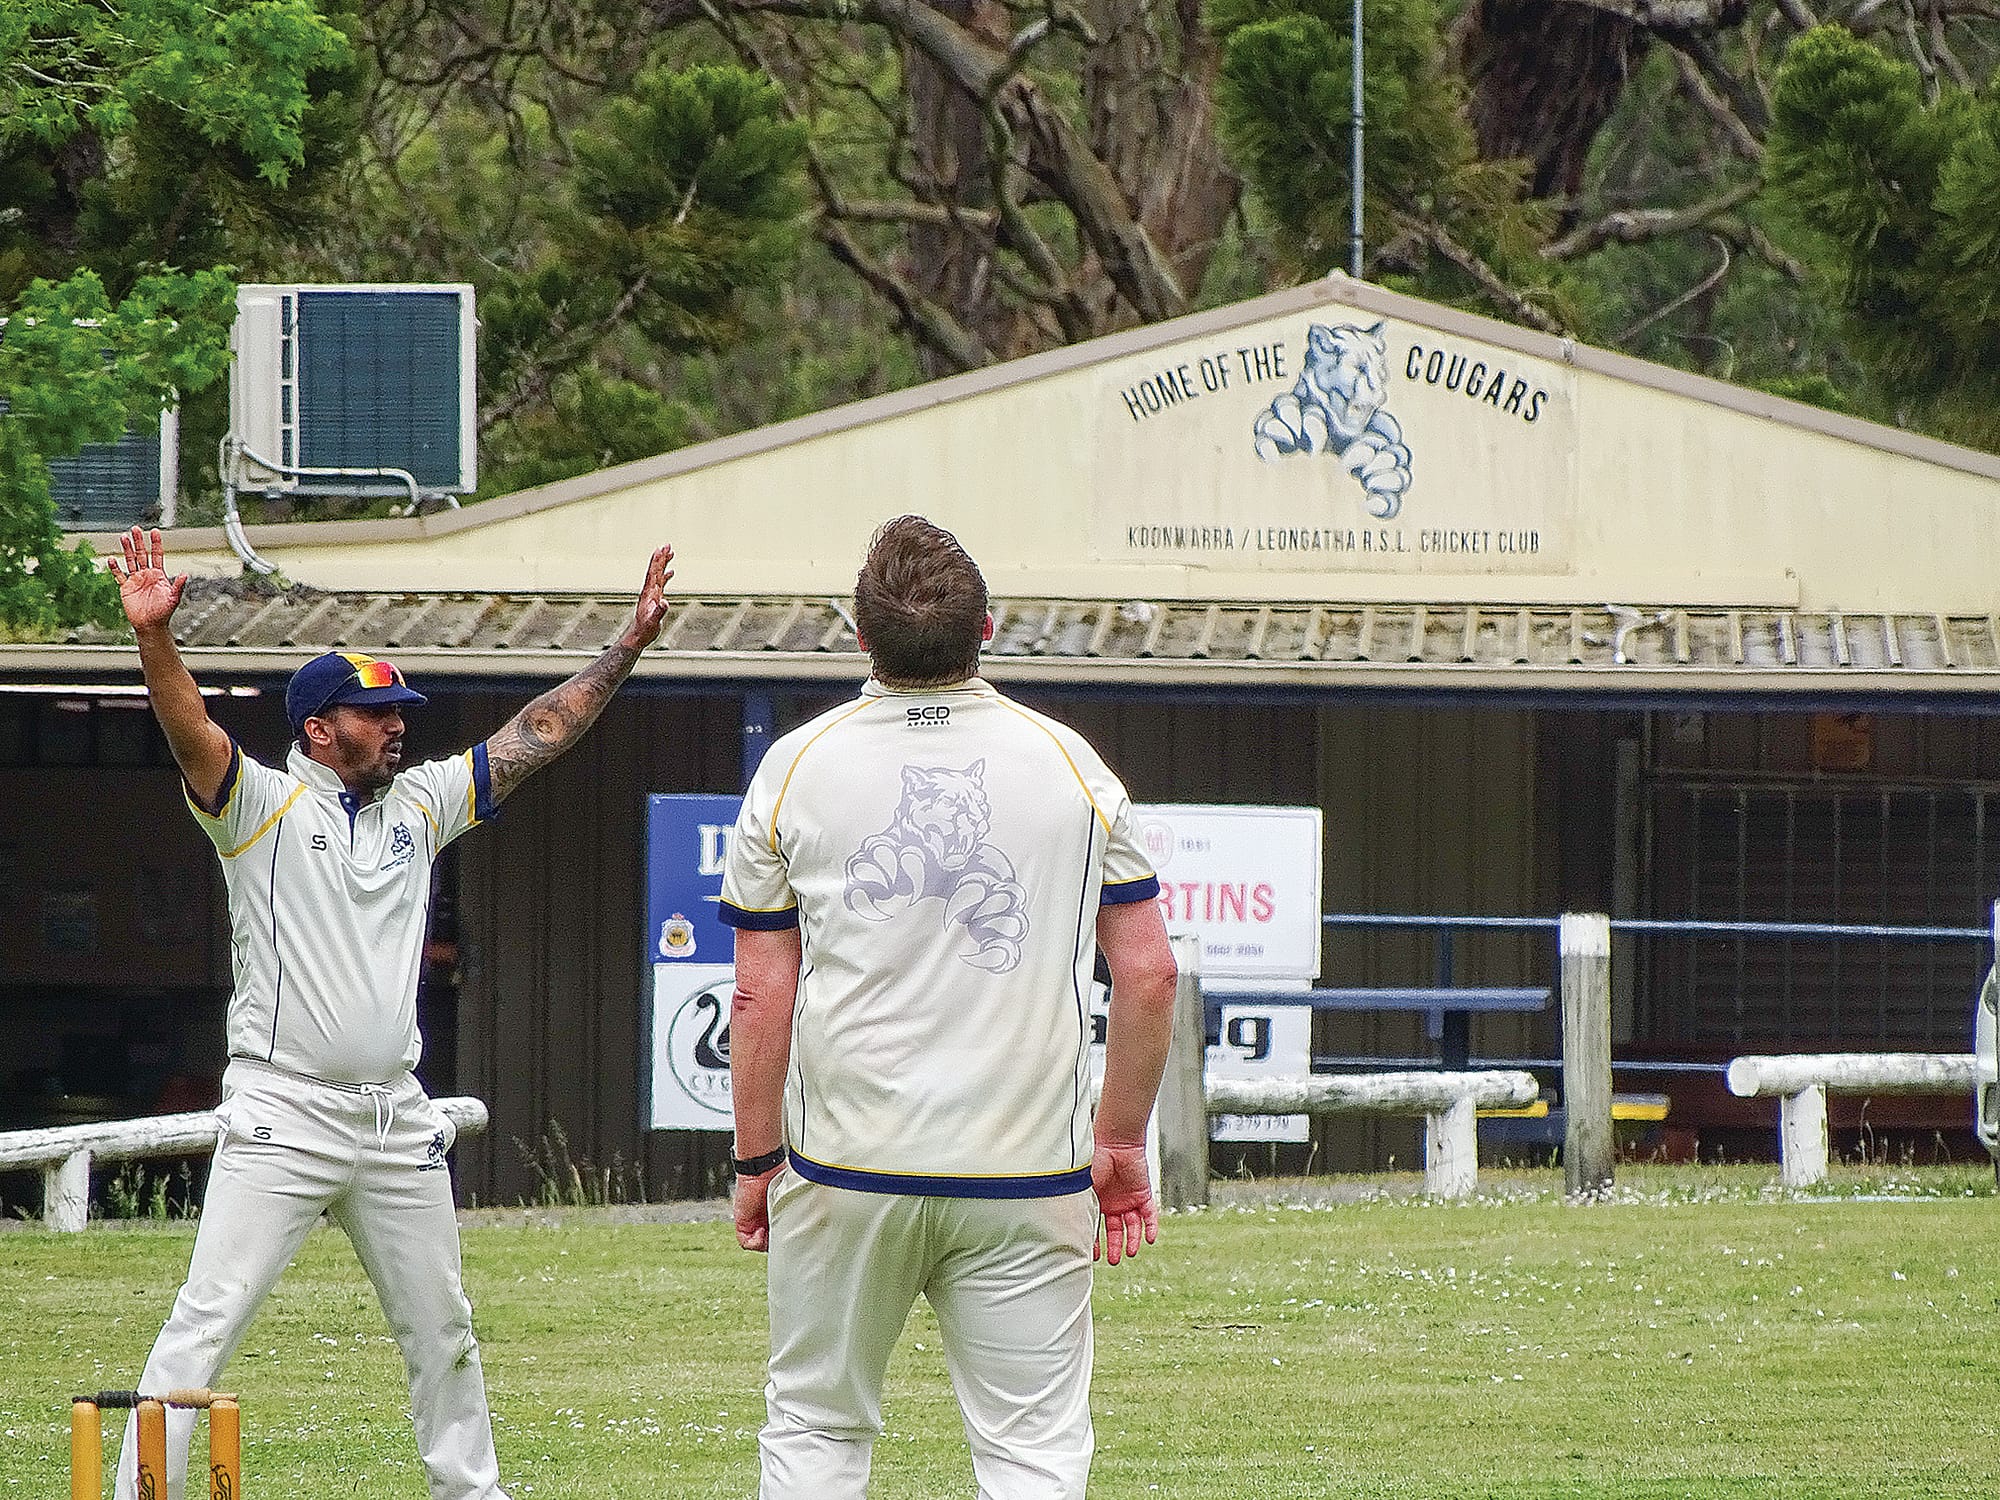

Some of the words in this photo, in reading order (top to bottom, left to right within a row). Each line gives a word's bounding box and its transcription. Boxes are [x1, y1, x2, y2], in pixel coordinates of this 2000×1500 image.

[1120, 364, 1199, 424] HOME
[1200, 353, 1230, 392] OF
[1236, 342, 1288, 384] THE
[1406, 345, 1549, 423] COUGARS
[1128, 526, 1234, 549] KOONWARRA
[1257, 528, 1356, 551] LEONGATHA
[1363, 530, 1411, 553] R.S.L.
[1420, 530, 1489, 554] CRICKET
[1498, 531, 1540, 554] CLUB
[907, 706, 950, 721] SCD
